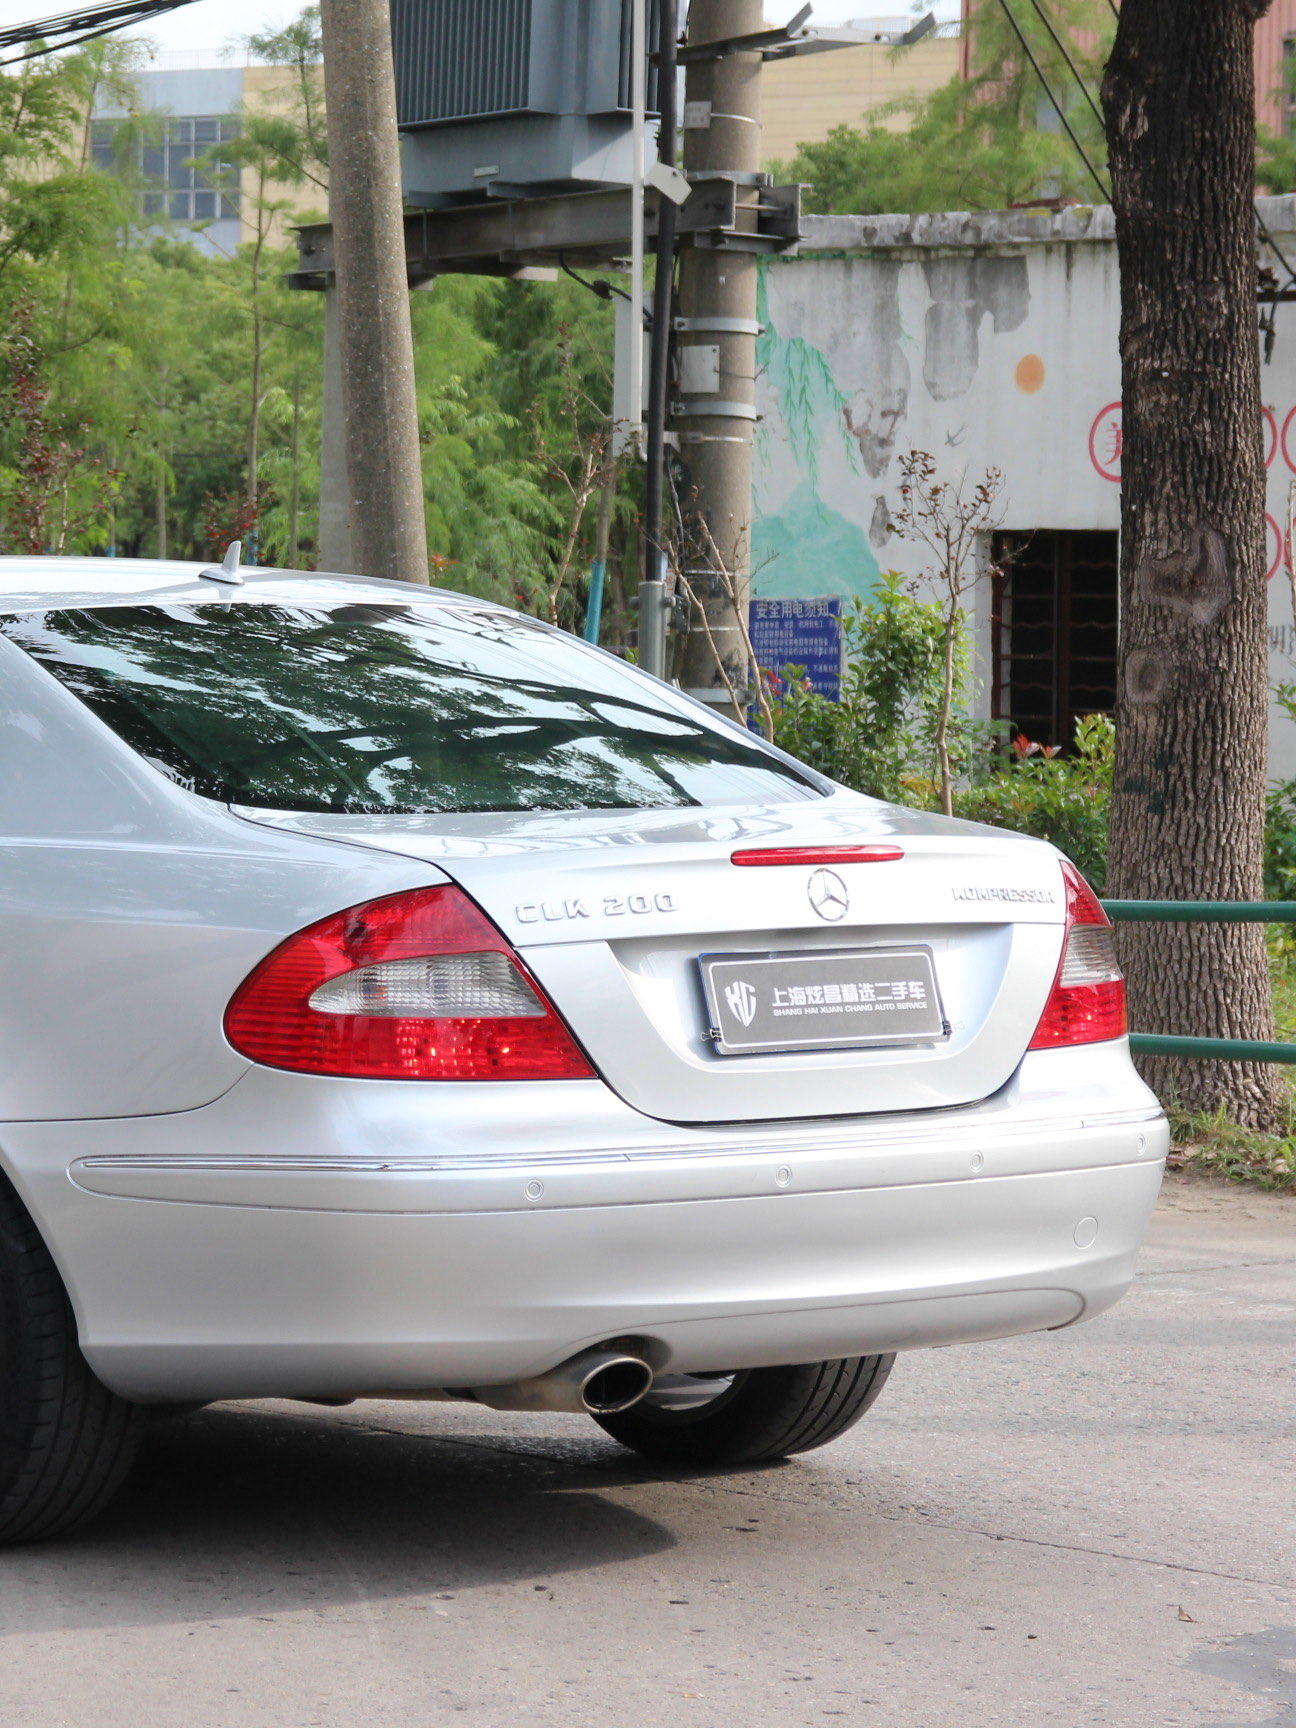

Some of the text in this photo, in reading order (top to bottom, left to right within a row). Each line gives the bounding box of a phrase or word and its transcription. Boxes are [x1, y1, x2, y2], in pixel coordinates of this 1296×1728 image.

[756, 601, 829, 619] 安全用电须知
[951, 887, 1056, 904] KOMPRESSOR
[515, 892, 680, 924] CLK 200
[772, 981, 926, 1007] 上海炫昌精选二手车
[773, 1001, 928, 1017] SHANG HAI XUAN CHANG AUTO SERVICE
